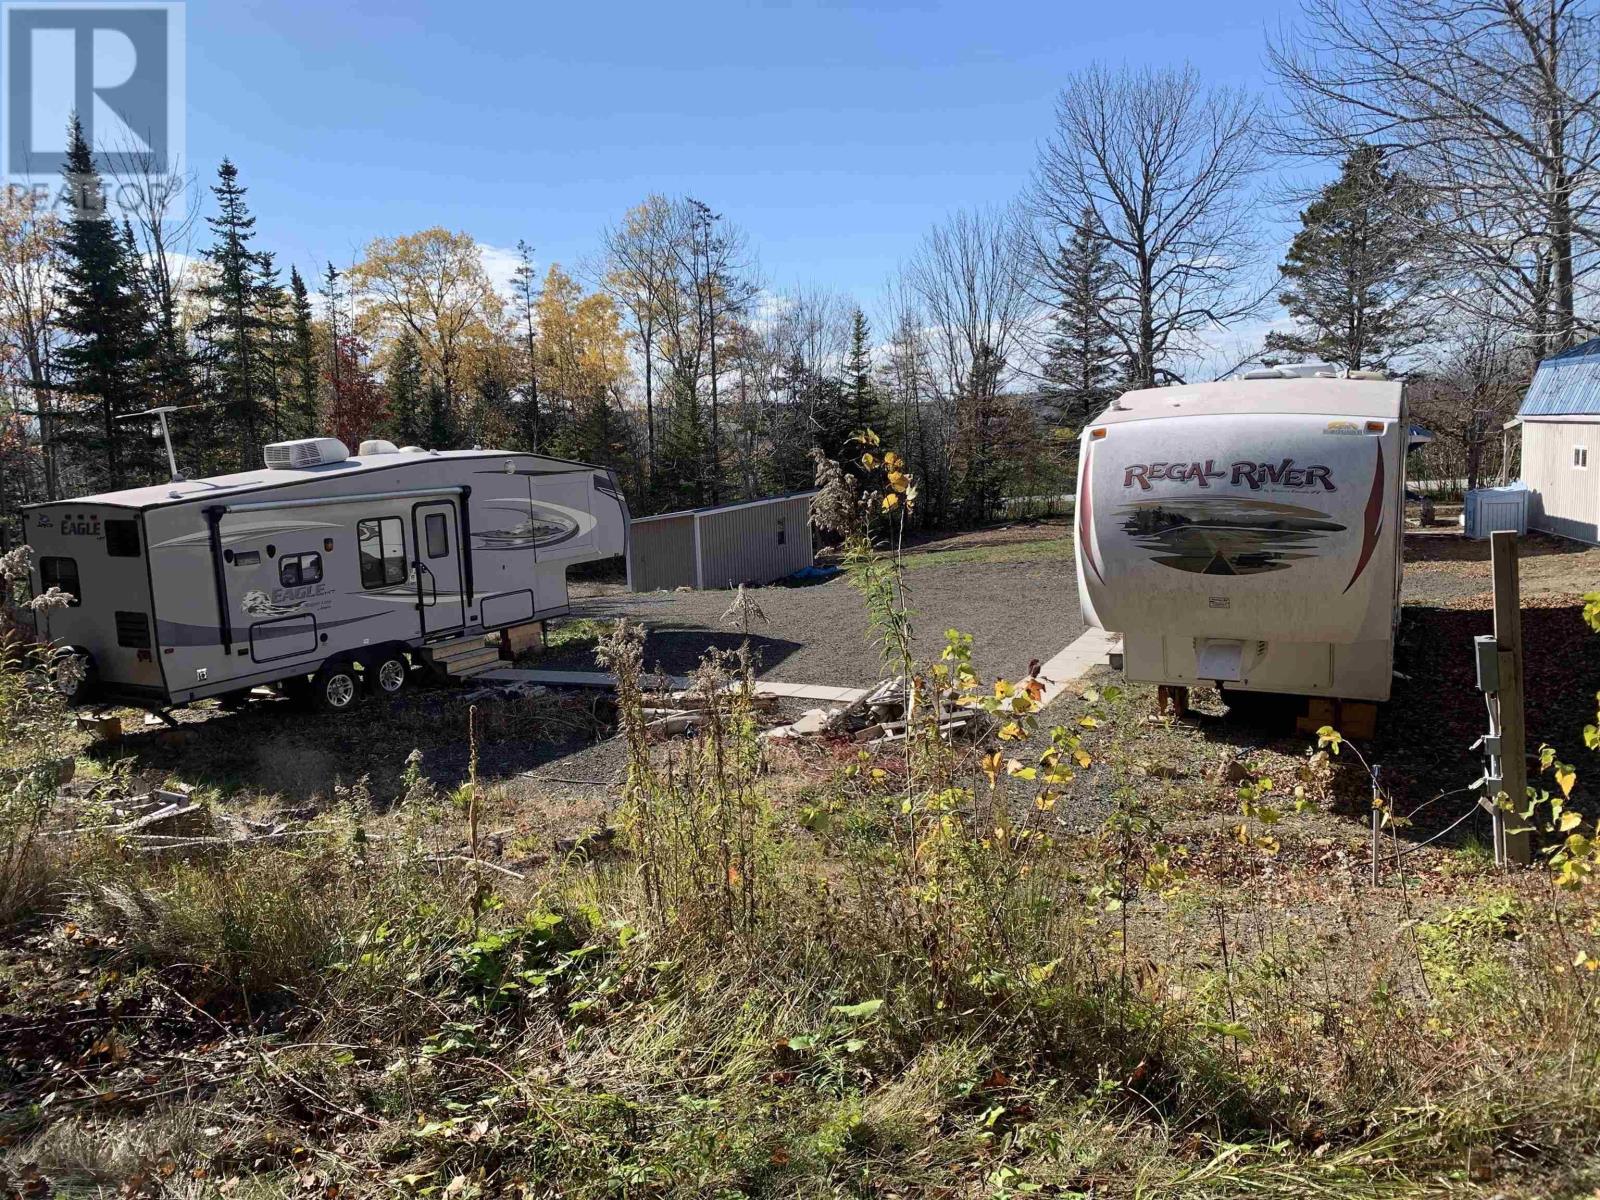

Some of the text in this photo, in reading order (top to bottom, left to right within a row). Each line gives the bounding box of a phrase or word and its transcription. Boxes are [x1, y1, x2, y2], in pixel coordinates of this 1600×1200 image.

[1123, 459, 1226, 490] REGAL
[61, 520, 101, 535] EAGLE
[272, 584, 326, 602] EAGLE
